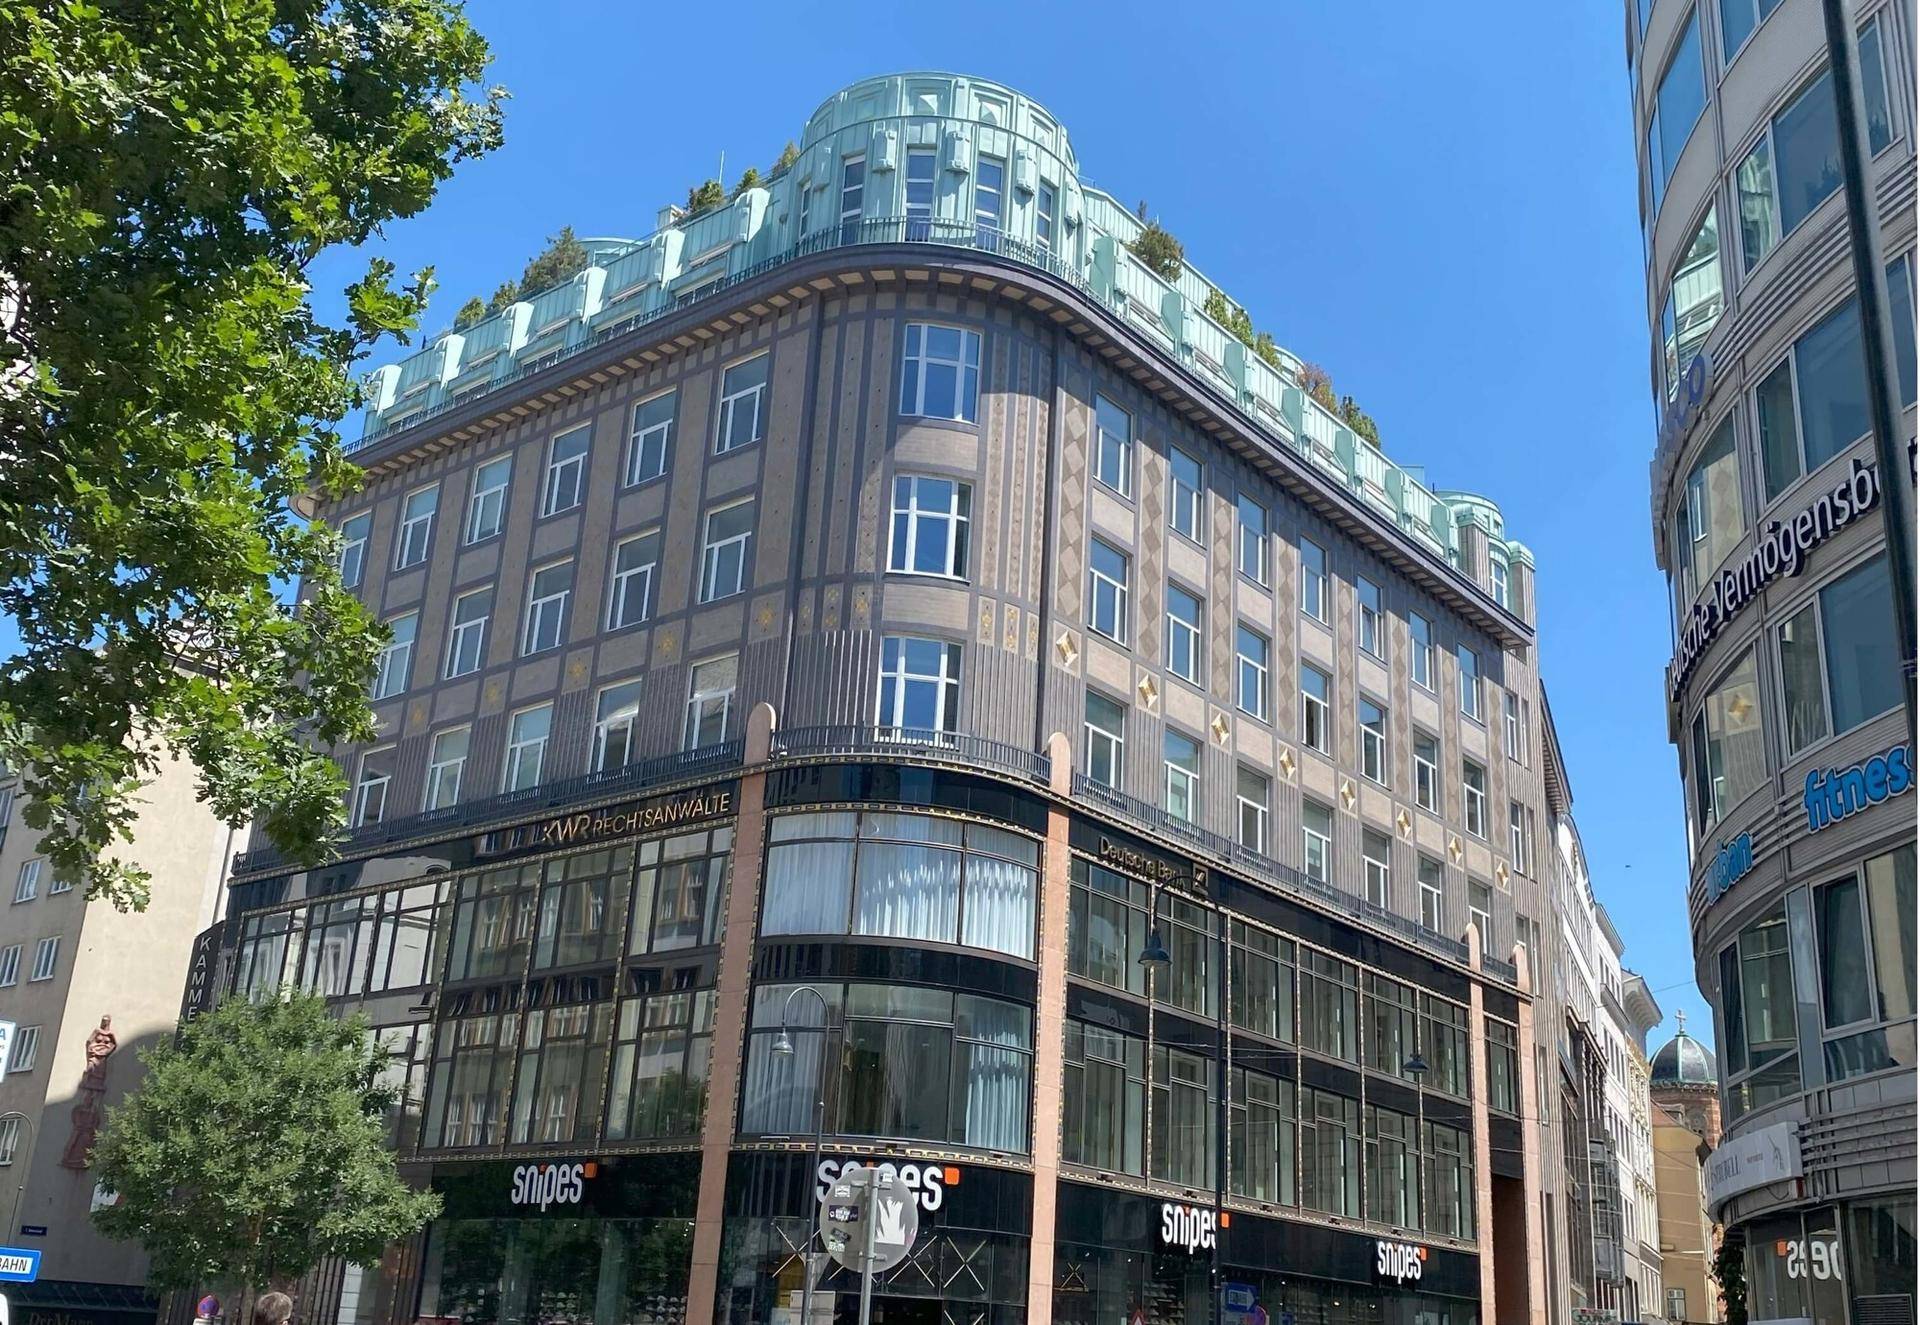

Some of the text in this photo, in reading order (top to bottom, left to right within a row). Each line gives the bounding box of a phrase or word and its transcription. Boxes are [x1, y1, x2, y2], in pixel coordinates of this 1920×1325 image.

[1712, 458, 1880, 622] Vermögensb
[1804, 743, 1913, 834] fitnes
[543, 793, 731, 846] KWR RECHTSANWÄLTE
[1100, 836, 1155, 875] Deutsche
[187, 936, 212, 1022] KAMME
[511, 1163, 584, 1212] snipes
[0, 1257, 28, 1272] AHN
[1377, 1240, 1422, 1285] snipes
